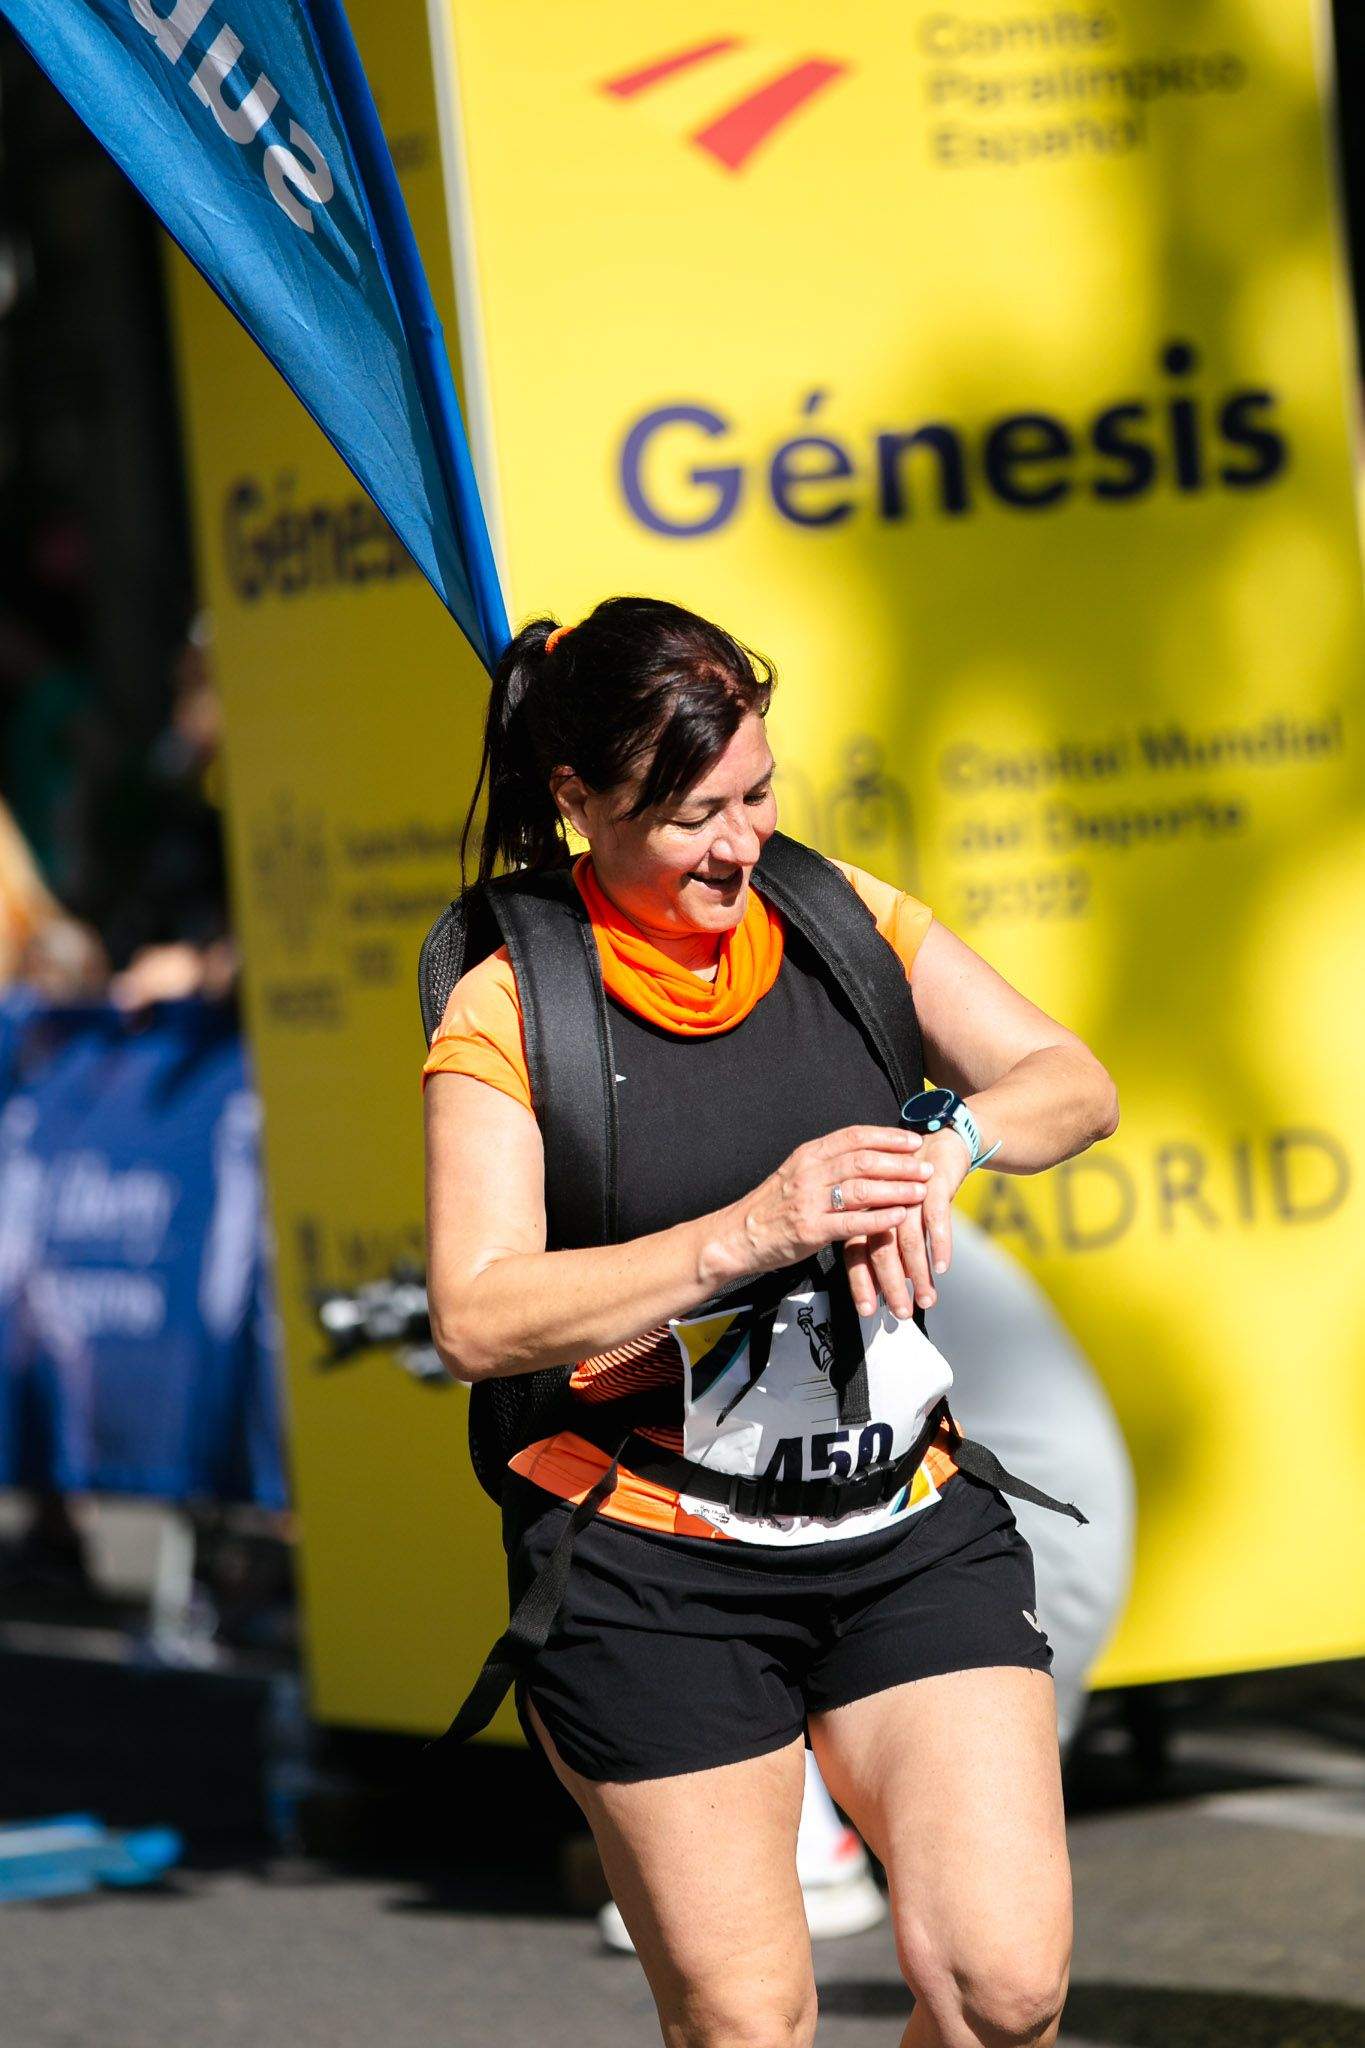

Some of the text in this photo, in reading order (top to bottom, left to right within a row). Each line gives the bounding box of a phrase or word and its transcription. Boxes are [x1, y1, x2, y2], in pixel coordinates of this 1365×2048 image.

[618, 341, 1290, 540] Génesis
[1137, 705, 1346, 770] Mundial
[976, 1126, 1353, 1259] ADRID
